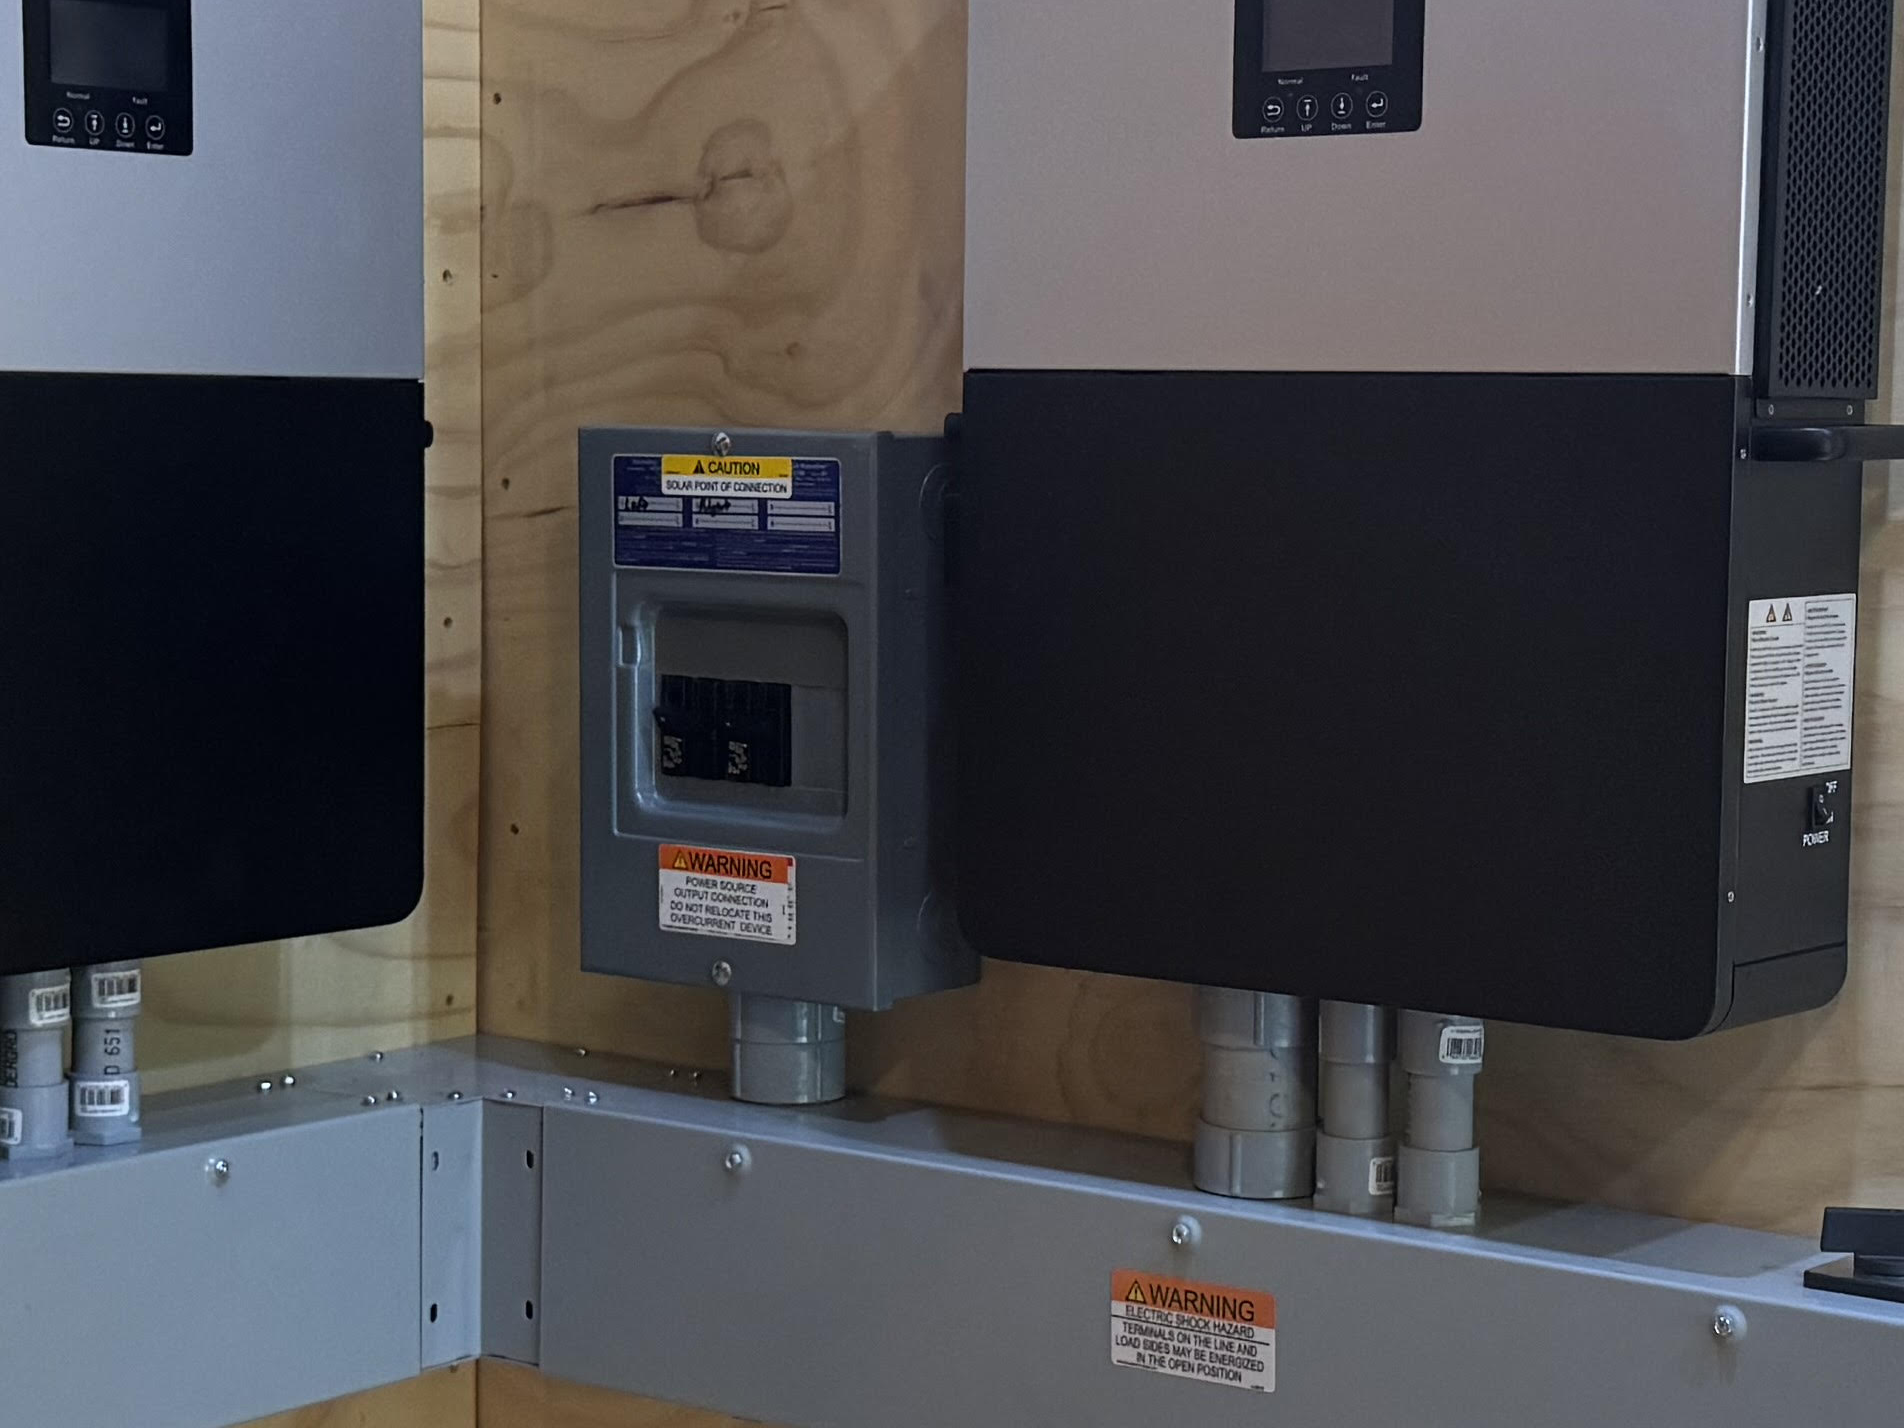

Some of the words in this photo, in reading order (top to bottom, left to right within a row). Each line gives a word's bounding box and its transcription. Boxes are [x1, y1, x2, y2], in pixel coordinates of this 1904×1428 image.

[707, 460, 760, 476] CAUTION
[666, 479, 693, 491] SOLAR
[694, 481, 718, 493] POINT
[720, 481, 732, 492] OF
[734, 481, 787, 494] CONNECTION
[1803, 830, 1829, 847] POWER
[688, 851, 772, 879] WARNING
[674, 887, 709, 902] OUTPUT
[710, 891, 769, 909] CONNECTION
[685, 876, 718, 889] POWER
[719, 881, 757, 895] SOURCE
[670, 901, 684, 911] DO
[685, 903, 703, 914] NOT
[704, 905, 750, 921] RELOCATE
[753, 910, 772, 923] THIS
[670, 912, 736, 931] OVERCURRENT
[739, 922, 772, 936] DEVICE
[104, 1028, 121, 1056] 651
[1149, 1283, 1255, 1322] WARNING
[1125, 1305, 1173, 1325] ELECTRIC
[1175, 1314, 1210, 1331] SHOCK
[1213, 1320, 1254, 1339] HAZARD
[1123, 1322, 1175, 1342] TERMINALS
[1176, 1332, 1191, 1345] ON
[1193, 1334, 1213, 1349] THE
[1214, 1338, 1234, 1353] LINE
[1236, 1342, 1258, 1357] AND
[1115, 1335, 1141, 1349] LOAD
[1142, 1339, 1171, 1355] SIDES
[1172, 1344, 1192, 1359] MAY
[1193, 1348, 1207, 1362] BE
[1209, 1350, 1264, 1373] ENERGIZED
[1136, 1353, 1146, 1364] IN
[1147, 1354, 1167, 1369] THE
[1168, 1357, 1195, 1373] OPEN
[1196, 1362, 1242, 1383] POSITION
